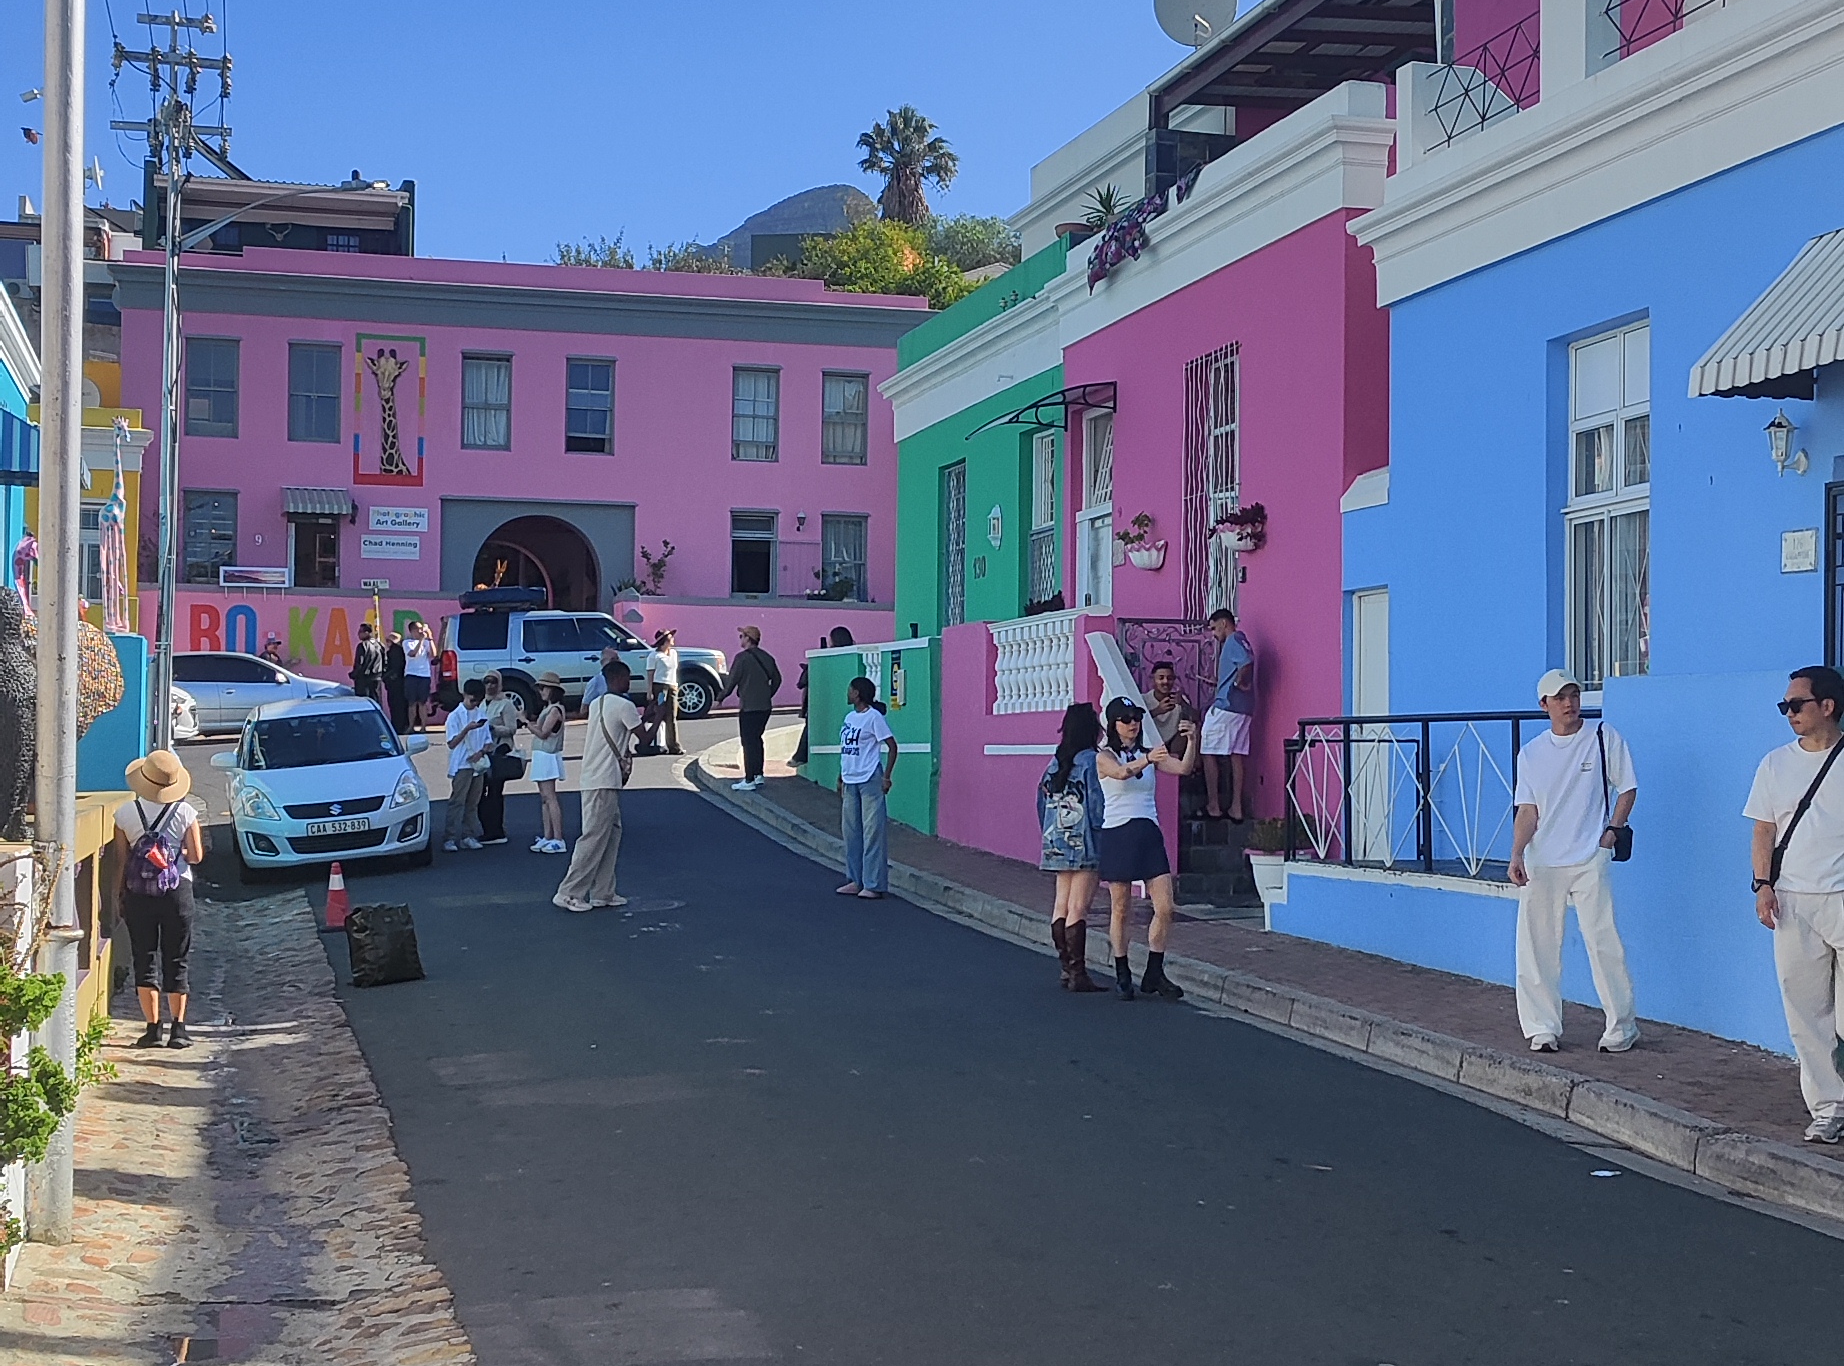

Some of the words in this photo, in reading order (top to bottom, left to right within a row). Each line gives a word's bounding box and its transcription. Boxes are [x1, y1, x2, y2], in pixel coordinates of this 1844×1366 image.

[390, 519, 420, 528] Gallery
[254, 534, 262, 546] 9
[385, 541, 418, 549] Henning
[310, 823, 328, 835] CAA
